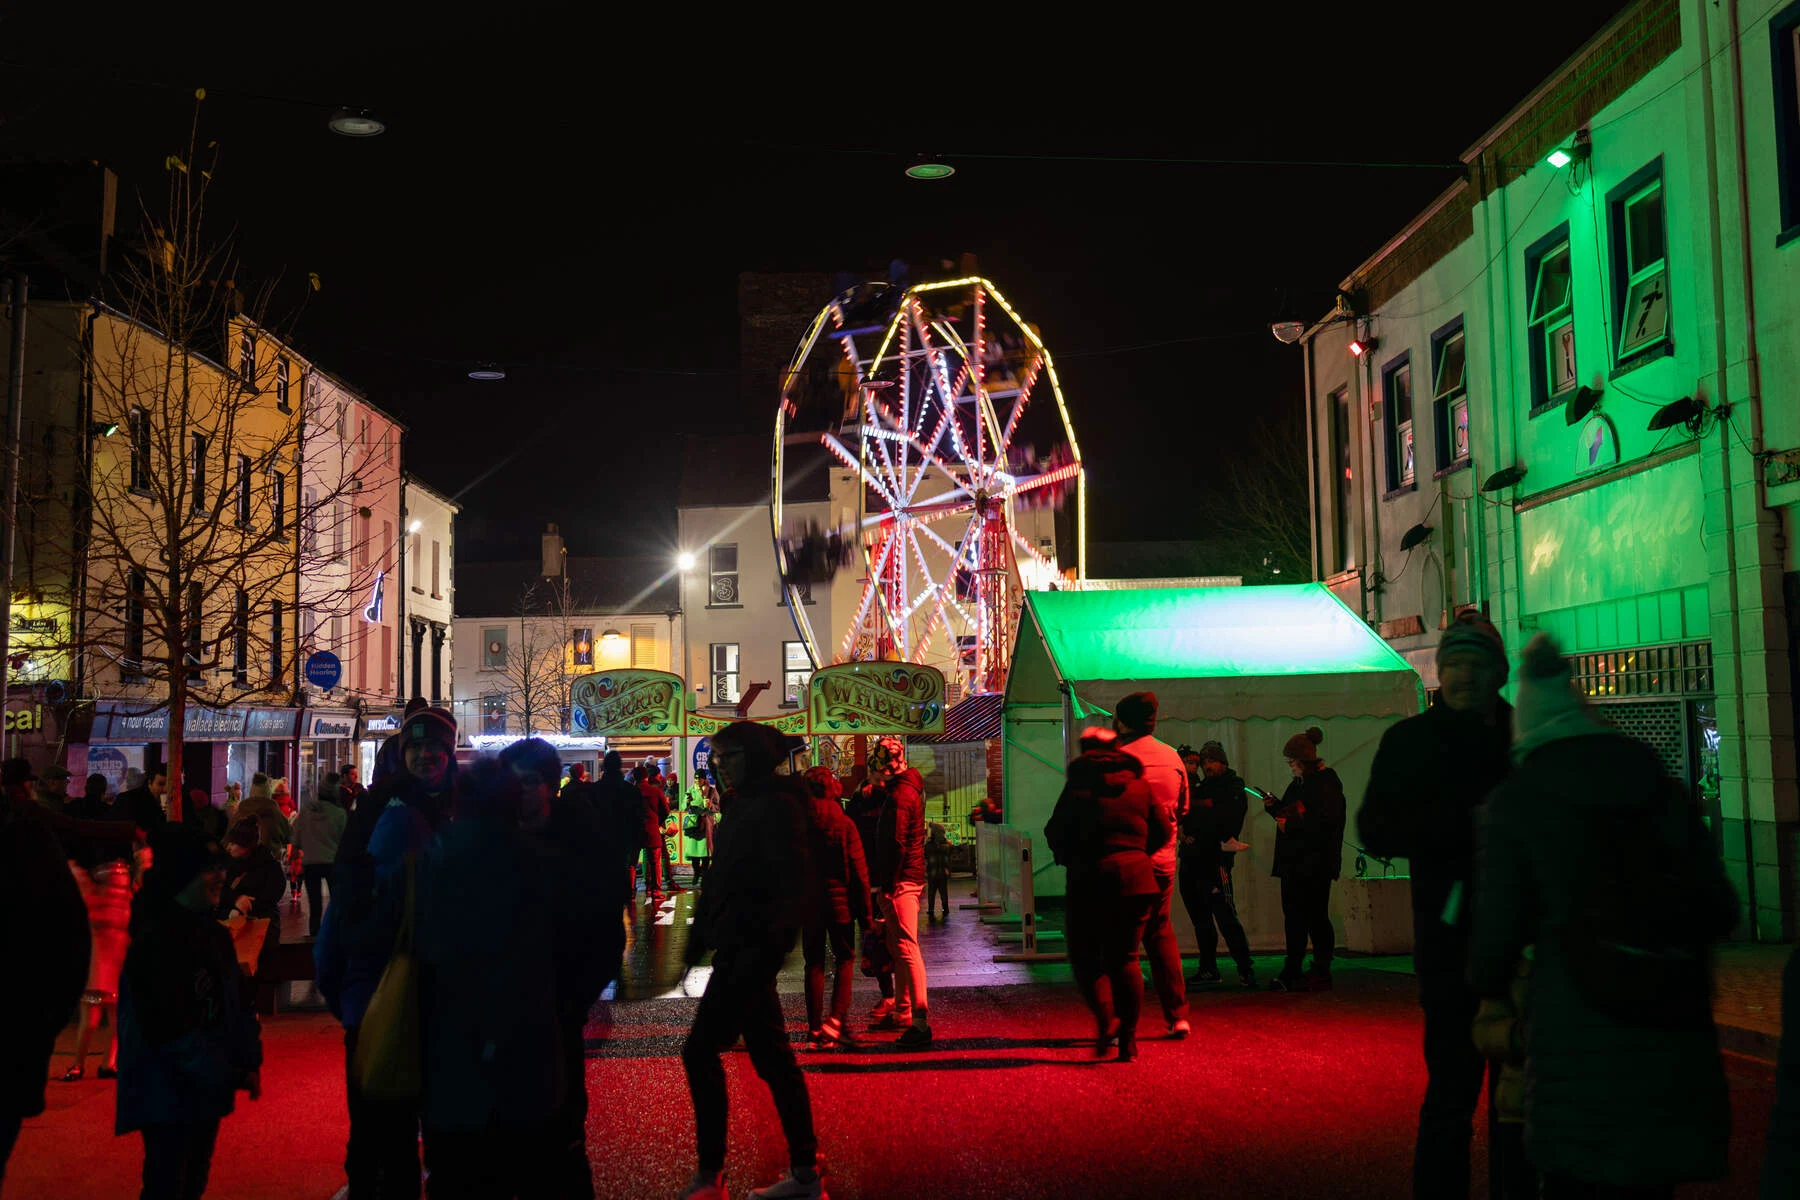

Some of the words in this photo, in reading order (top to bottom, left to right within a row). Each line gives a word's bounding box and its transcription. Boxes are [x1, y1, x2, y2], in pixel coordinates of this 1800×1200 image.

[717, 578, 734, 600] 3
[588, 684, 665, 731] FERRIS
[832, 680, 920, 727] WHEEL
[143, 715, 164, 733] repairs
[186, 716, 212, 732] wallace
[213, 716, 244, 732] electrical
